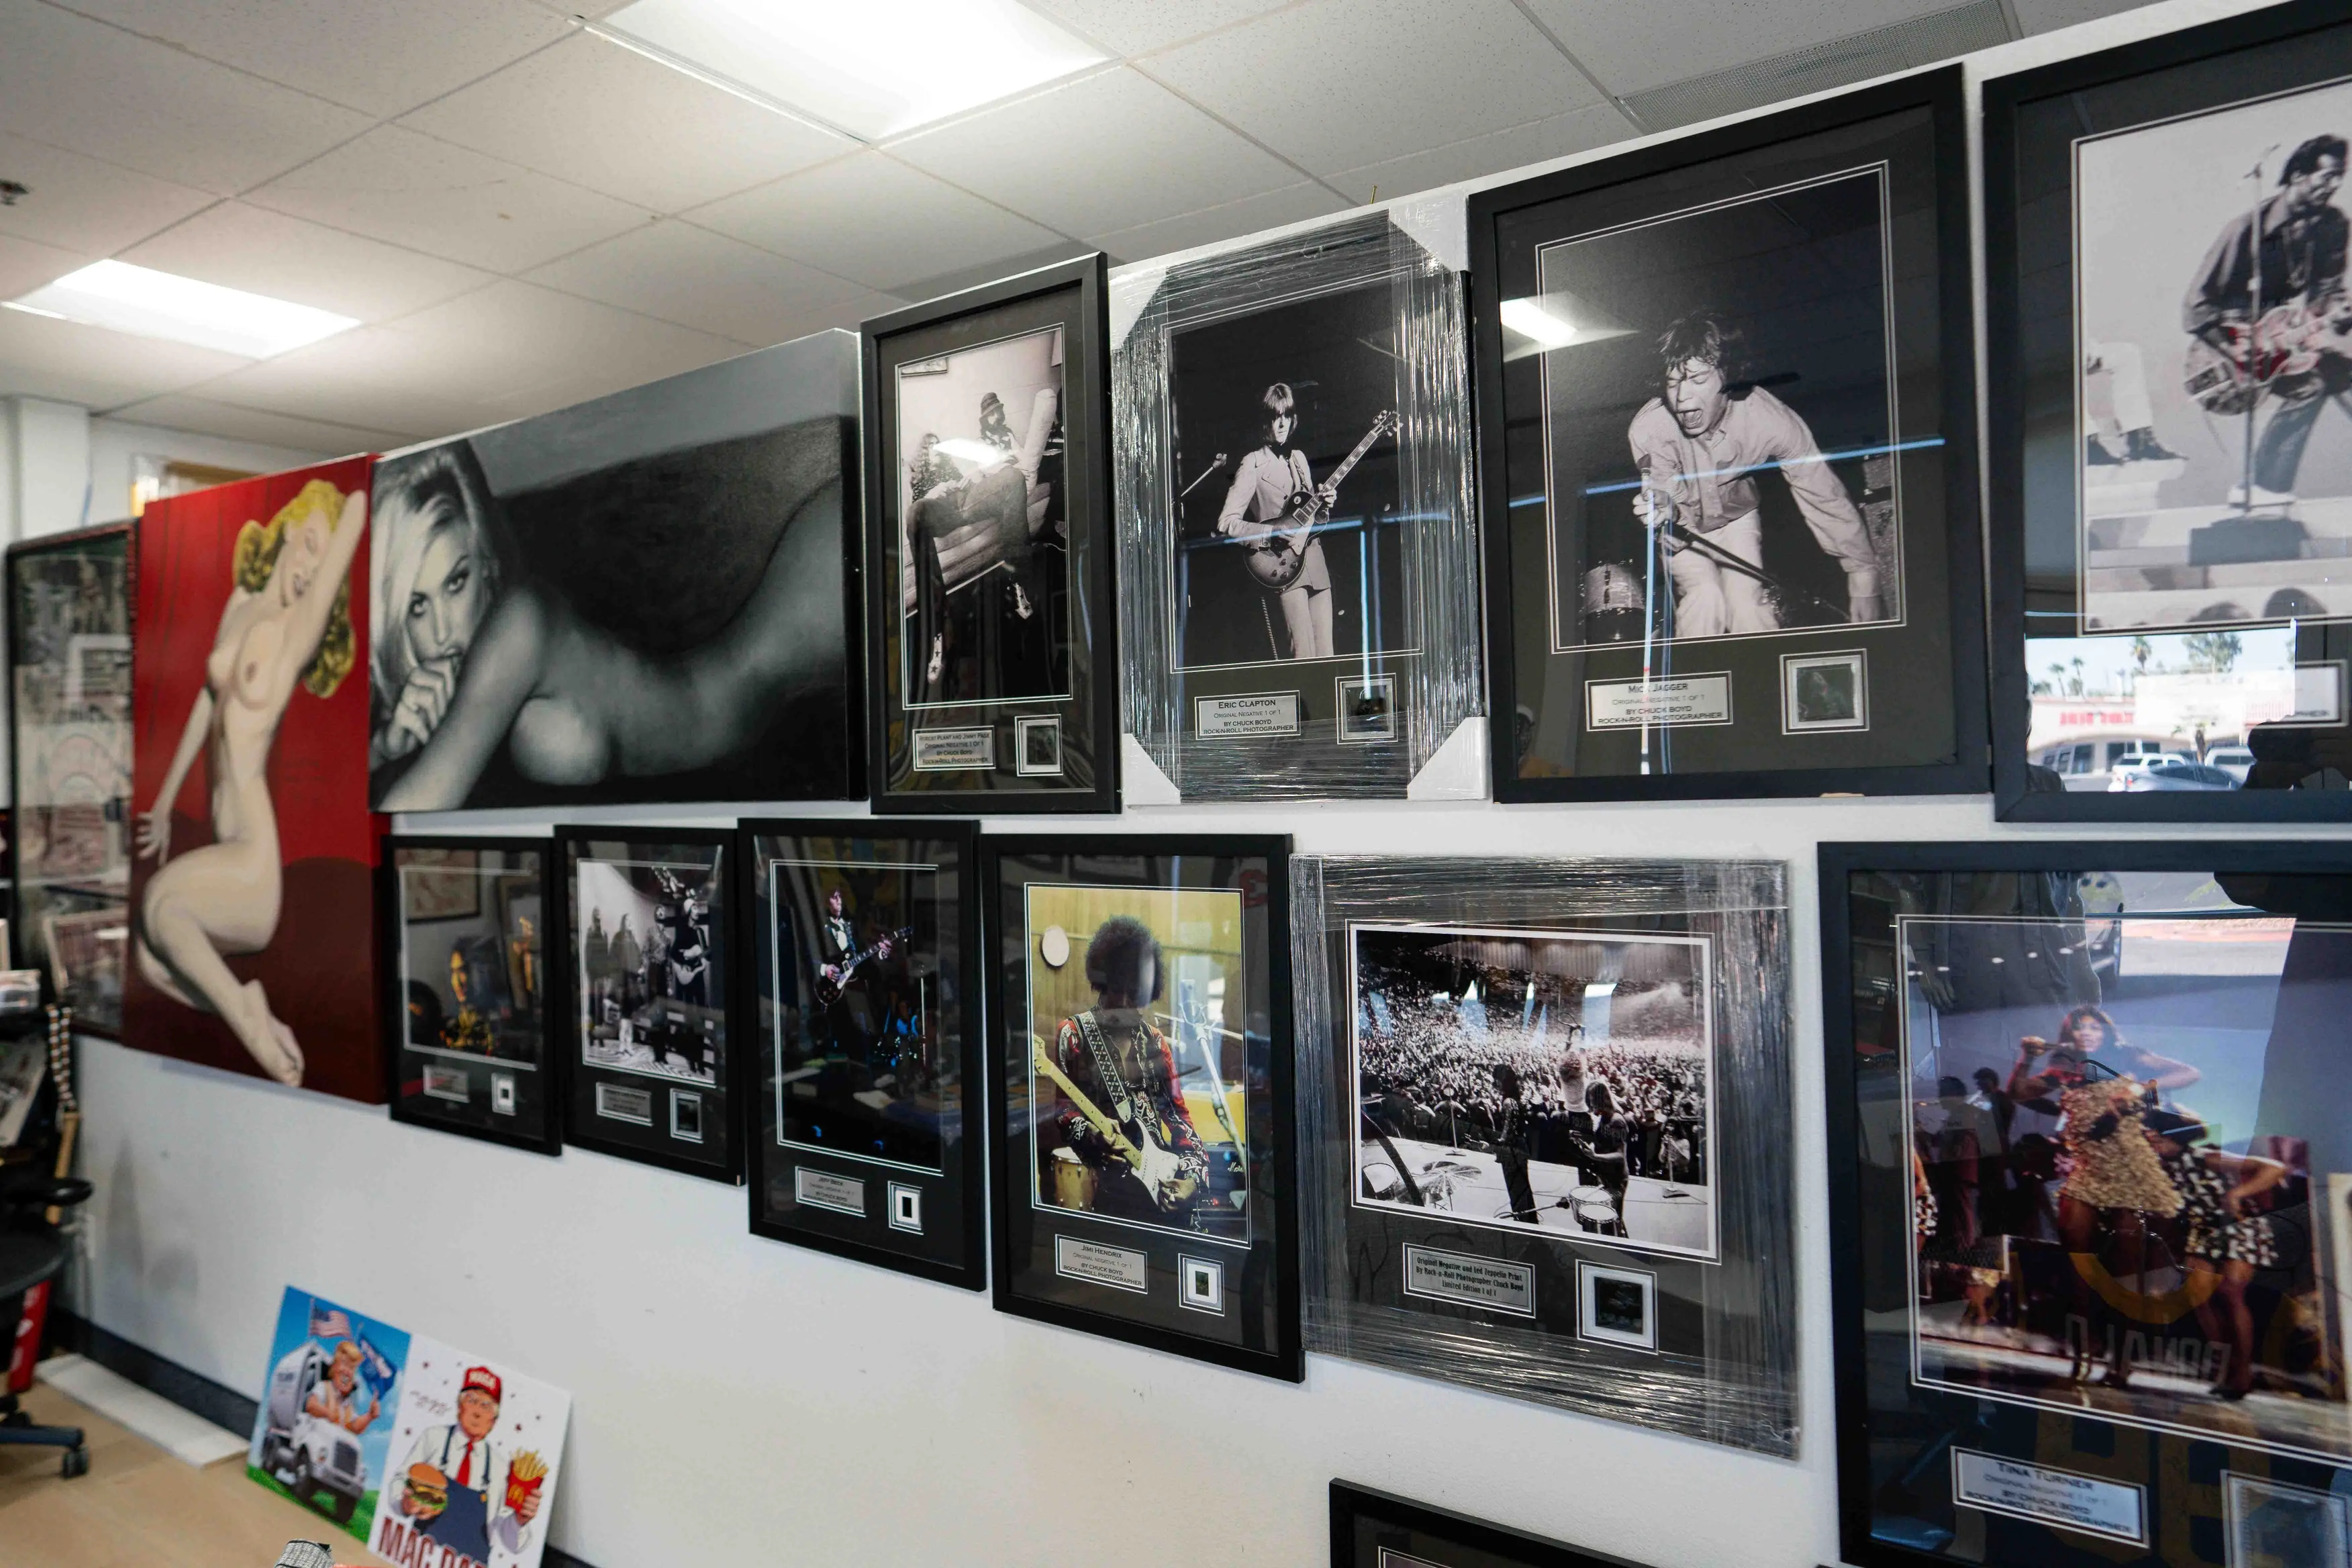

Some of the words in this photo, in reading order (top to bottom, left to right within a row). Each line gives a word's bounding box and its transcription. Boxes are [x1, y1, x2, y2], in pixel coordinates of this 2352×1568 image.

[1653, 683, 1688, 692] JAGGER
[1598, 716, 1651, 724] ROCK-N-ROLL
[1653, 712, 1722, 721] PHOTOGRAPHER
[1073, 1253, 1093, 1261] ORIGINAL
[1095, 1258, 1116, 1266] NEGATIVE
[1095, 1248, 1122, 1258] HENDRIX
[1064, 1265, 1098, 1277] ROCK-N-ROLL
[1098, 1273, 1142, 1285] PHOTOGRAPHER
[1089, 1265, 1107, 1273] CHUCK
[1417, 1257, 1437, 1266] Original
[1439, 1261, 1461, 1271] Negative
[1484, 1268, 1506, 1279] Zeppelin
[1508, 1272, 1522, 1281] Print
[1416, 1267, 1423, 1275] By
[1424, 1268, 1454, 1279] Rock-n-Roll
[1457, 1273, 1492, 1286] Photographer
[1493, 1280, 1509, 1288] Chuck
[1442, 1280, 1461, 1290] Limited
[1463, 1284, 1481, 1293] Edition
[1486, 1288, 1492, 1296] of
[1997, 1463, 2030, 1477] TINA
